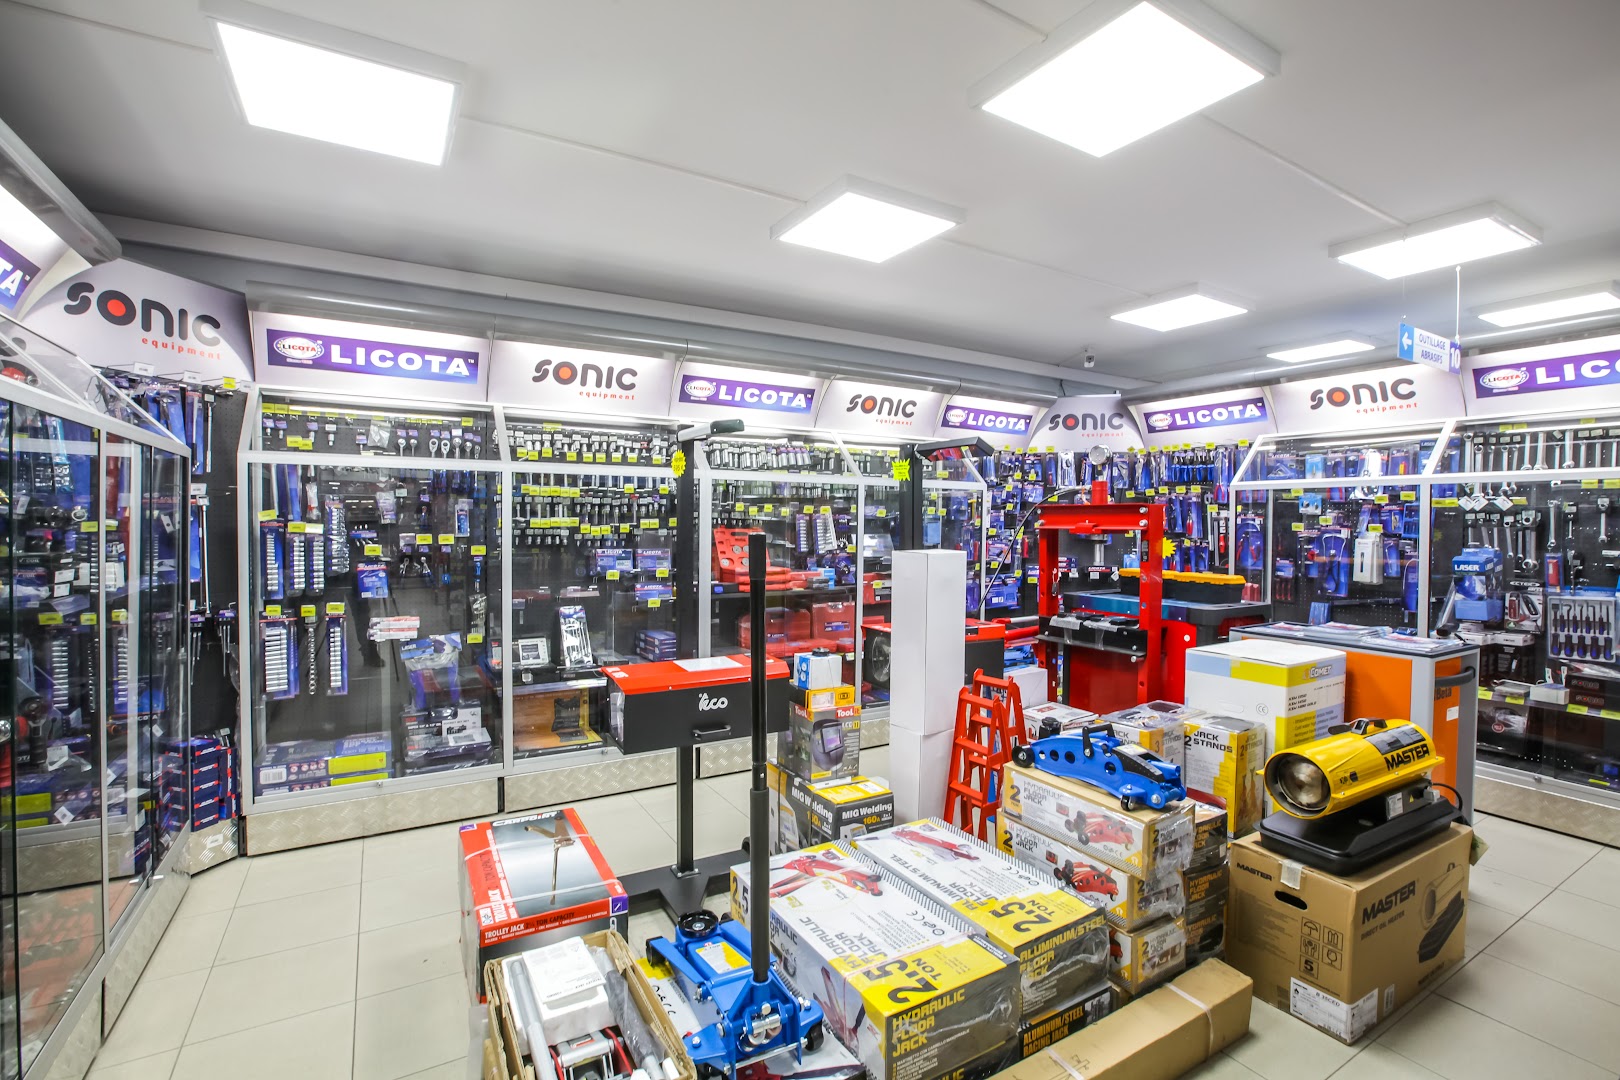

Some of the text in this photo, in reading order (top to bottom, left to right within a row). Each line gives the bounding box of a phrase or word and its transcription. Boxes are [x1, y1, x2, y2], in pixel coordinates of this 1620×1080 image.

[142, 337, 221, 360] equipment
[282, 344, 317, 352] LICOTA
[1418, 333, 1446, 351] OUTILLAGE
[331, 344, 469, 376] LICOTA
[1420, 349, 1443, 364] ABRASIFS
[1450, 347, 1461, 369] 10
[1488, 374, 1521, 383] LICOTA
[1535, 358, 1620, 385] LIC
[579, 390, 635, 400] equipment
[718, 385, 807, 408] LICOTA
[1174, 404, 1262, 426] LICOTA
[1356, 402, 1418, 415] equipment
[876, 418, 913, 426] equipment
[967, 412, 1026, 431] LICOTA
[1184, 735, 1192, 747] 2
[1193, 730, 1219, 742] JACK
[1193, 739, 1233, 753] STANDS
[1155, 740, 1160, 753] 3
[1240, 744, 1245, 756] 2
[1383, 743, 1430, 772] MASTER
[791, 786, 804, 802] MIG
[1010, 784, 1021, 804] 2
[1023, 780, 1063, 801] HYDRAULIC
[1023, 787, 1047, 801] FLOOR
[1023, 794, 1043, 807] JACK
[842, 803, 892, 820] MIG Welding
[1003, 829, 1013, 849] 2
[1016, 826, 1053, 849] HYDRAULIC
[1016, 833, 1038, 849] FLOOR
[1152, 829, 1159, 843] 2
[1016, 841, 1034, 853] JACK
[891, 853, 978, 911] ALUMINUM/STEEL
[1189, 870, 1223, 887] HYDRAULIC
[1236, 862, 1273, 882] MASTER
[731, 876, 749, 915] 2.5
[948, 882, 988, 907] FLOOR
[966, 882, 999, 901] JACK
[1137, 880, 1145, 894] 2
[1028, 899, 1056, 917] TON
[1361, 880, 1416, 925] MASTER
[485, 927, 509, 939] TROLLEY
[510, 923, 525, 932] JACK
[536, 918, 548, 926] TON
[550, 912, 575, 923] CAPACITY
[988, 901, 1052, 933] 2.5
[1361, 910, 1405, 940] DIRECT OIL HEATER
[799, 916, 862, 969] HYDRAULIC
[834, 932, 874, 963] FLOOR
[853, 932, 888, 958] JACK
[1020, 914, 1106, 962] ALUMINUM/STEEL
[1142, 942, 1149, 955] 2
[911, 957, 943, 981] TON
[1020, 950, 1055, 973] FLOOR
[1304, 959, 1314, 972] 5
[863, 959, 939, 1004] 2.5
[892, 988, 965, 1029] HYDRAULIC
[892, 1015, 935, 1045] FLOOR
[1023, 1005, 1084, 1046] ALUMINUM/STEEL
[892, 1032, 928, 1058] JACK
[1023, 1024, 1069, 1057] RACING JACK
